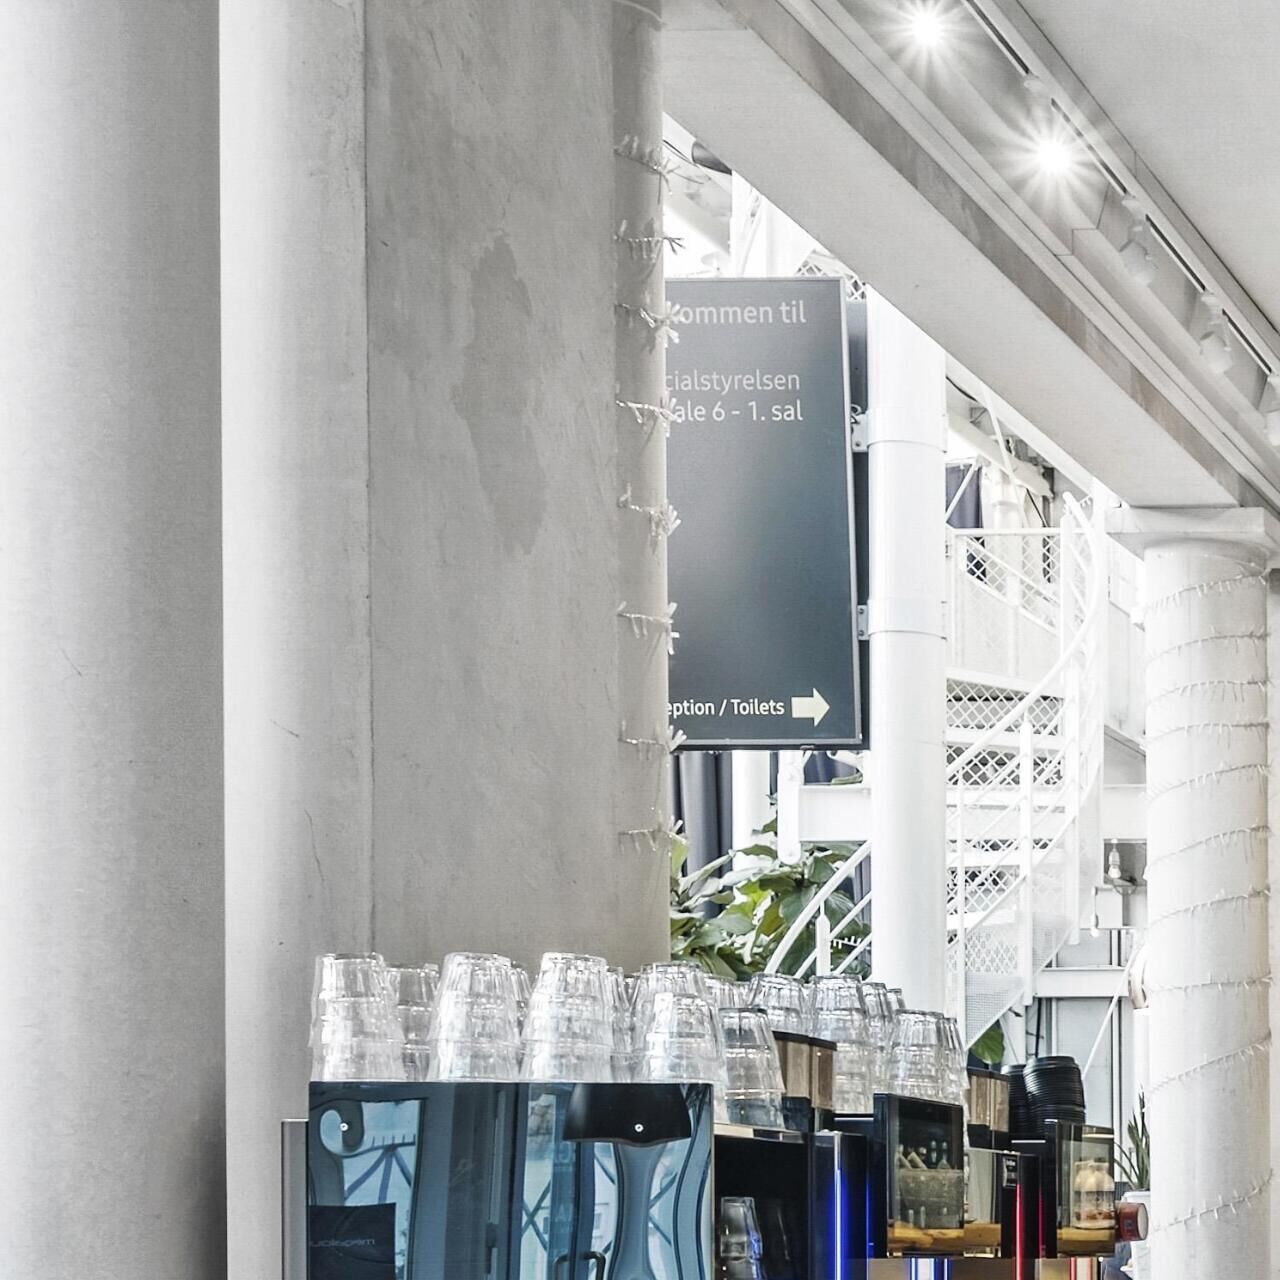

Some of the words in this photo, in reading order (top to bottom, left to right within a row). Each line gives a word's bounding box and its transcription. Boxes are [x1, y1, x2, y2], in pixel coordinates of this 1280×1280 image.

[779, 300, 807, 324] til
[670, 399, 706, 422] ale
[712, 400, 726, 421] 6
[748, 400, 766, 421] 1.
[771, 399, 803, 421] sal
[730, 698, 785, 716] Toilets
